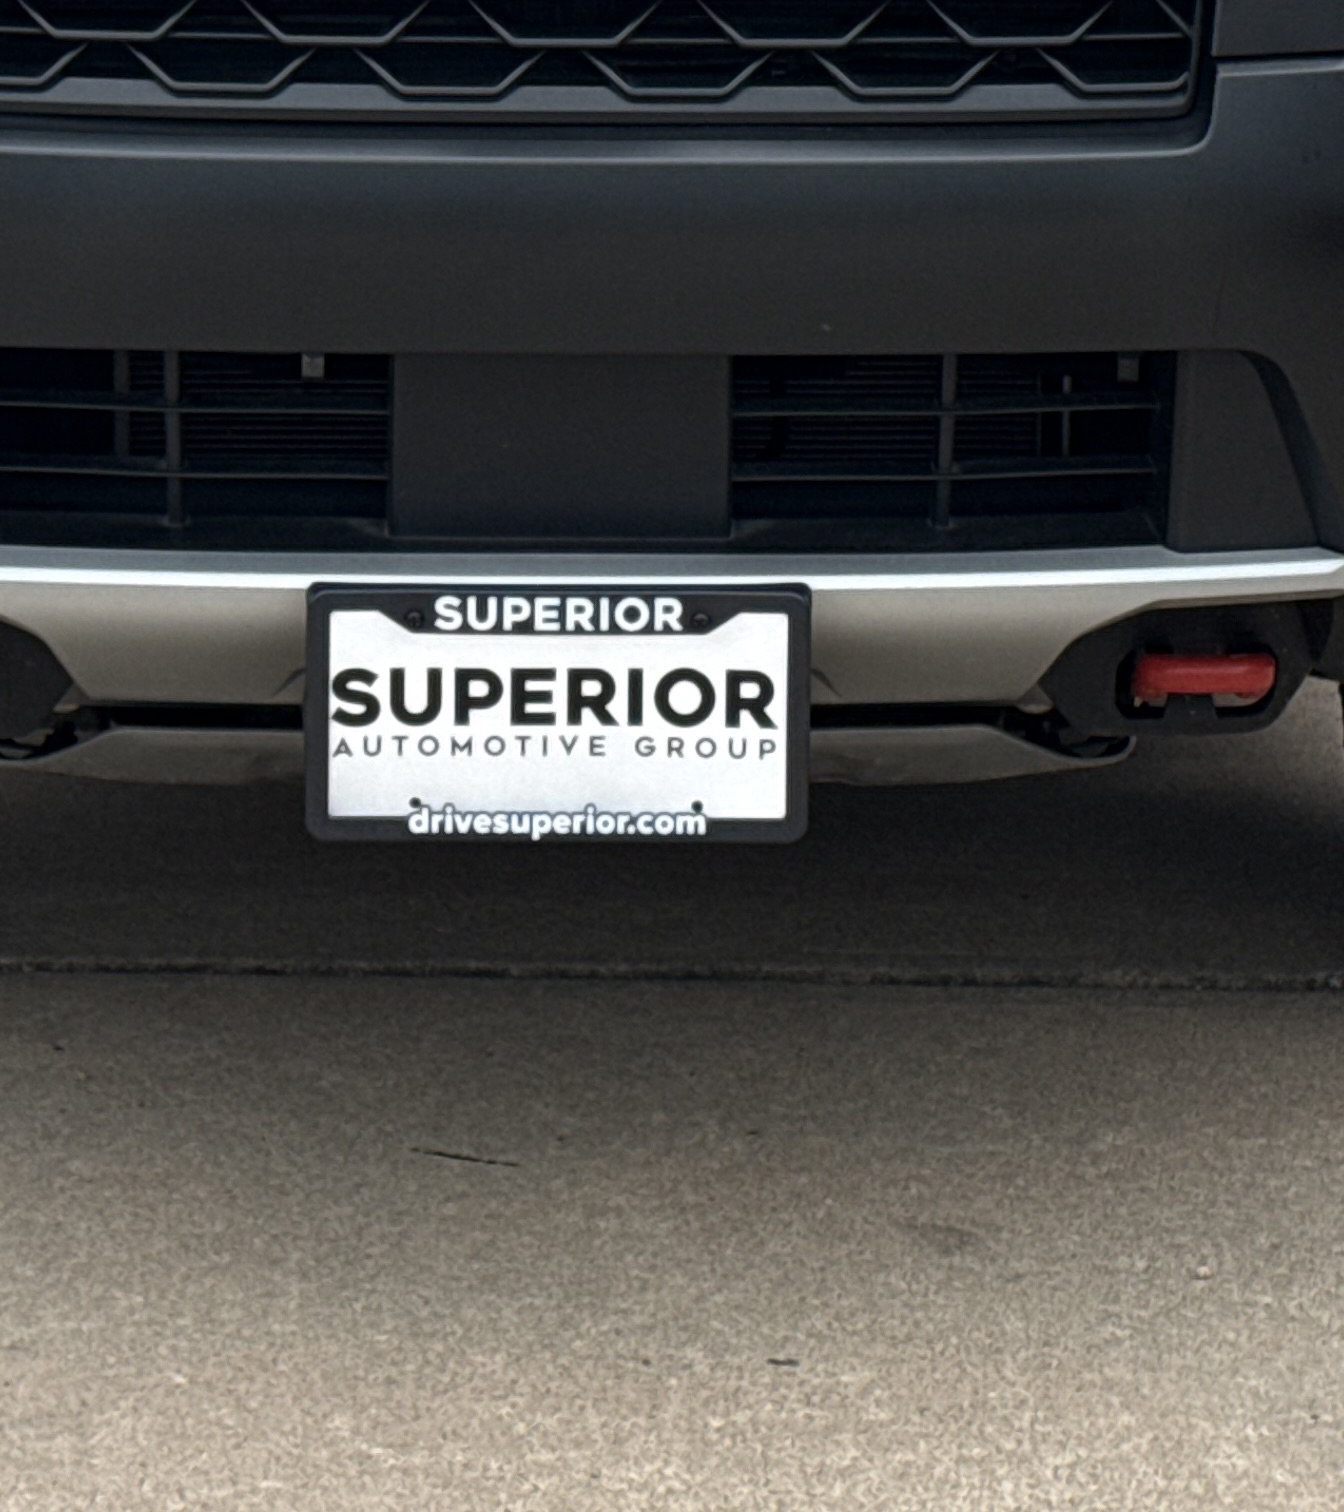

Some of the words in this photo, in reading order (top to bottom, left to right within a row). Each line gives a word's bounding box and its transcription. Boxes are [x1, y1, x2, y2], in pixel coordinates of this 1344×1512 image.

[434, 596, 683, 632] SUPERIOR
[331, 667, 778, 729] SUPERIOR
[333, 735, 607, 758] AUTOMOTIVE
[634, 736, 777, 760] GROUP
[408, 802, 707, 840] drivesuperior.com
